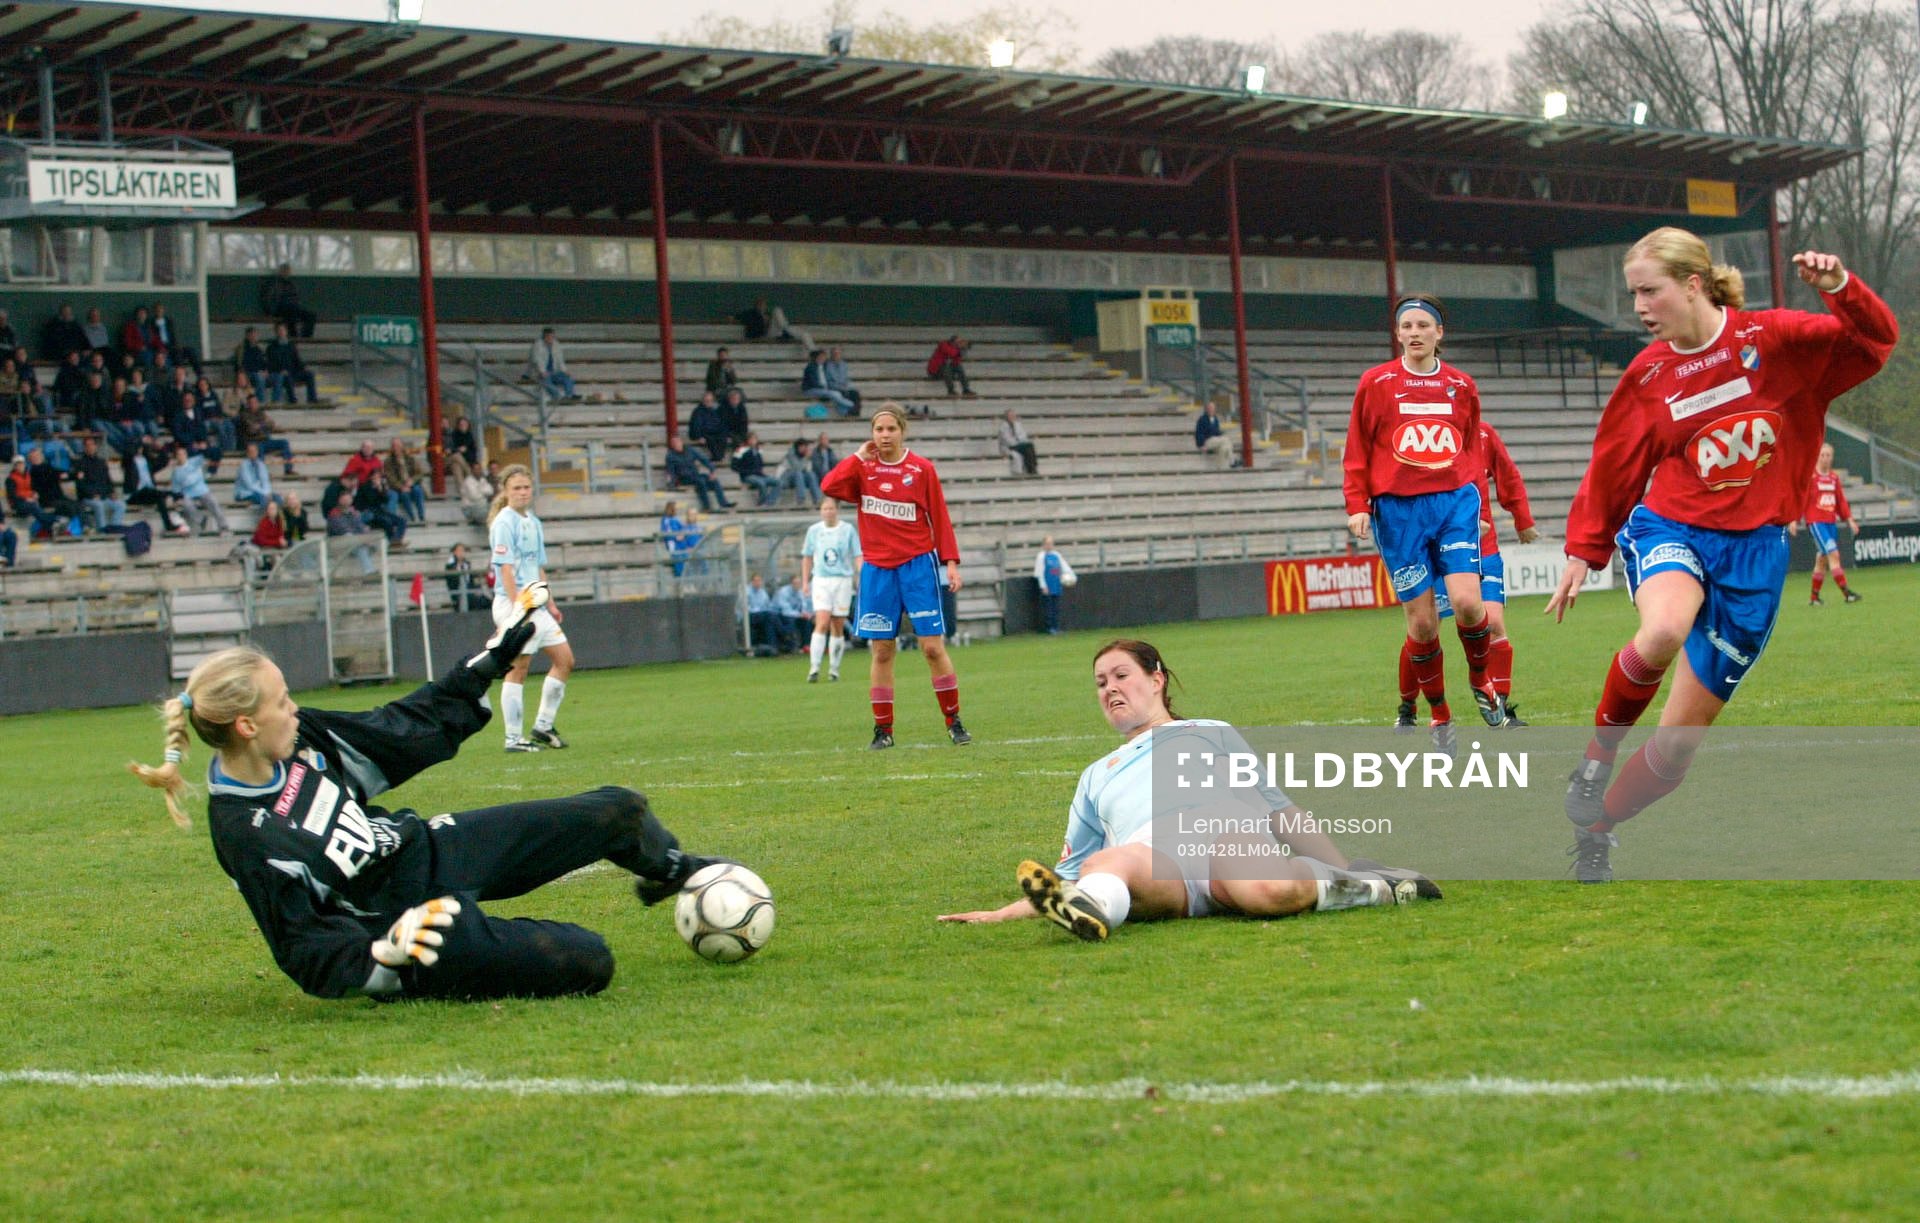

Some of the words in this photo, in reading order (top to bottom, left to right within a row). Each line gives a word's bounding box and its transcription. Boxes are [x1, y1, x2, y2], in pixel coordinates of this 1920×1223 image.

[46, 165, 221, 199] TIPSLÄKTAREN
[1151, 303, 1188, 321] KIOSK
[1677, 360, 1703, 377] TEAM
[1398, 424, 1457, 453] AXA
[1698, 417, 1776, 478] AXA
[866, 499, 915, 518] PROTON
[1305, 561, 1372, 592] McFrukost
[1508, 564, 1557, 590] LPHI
